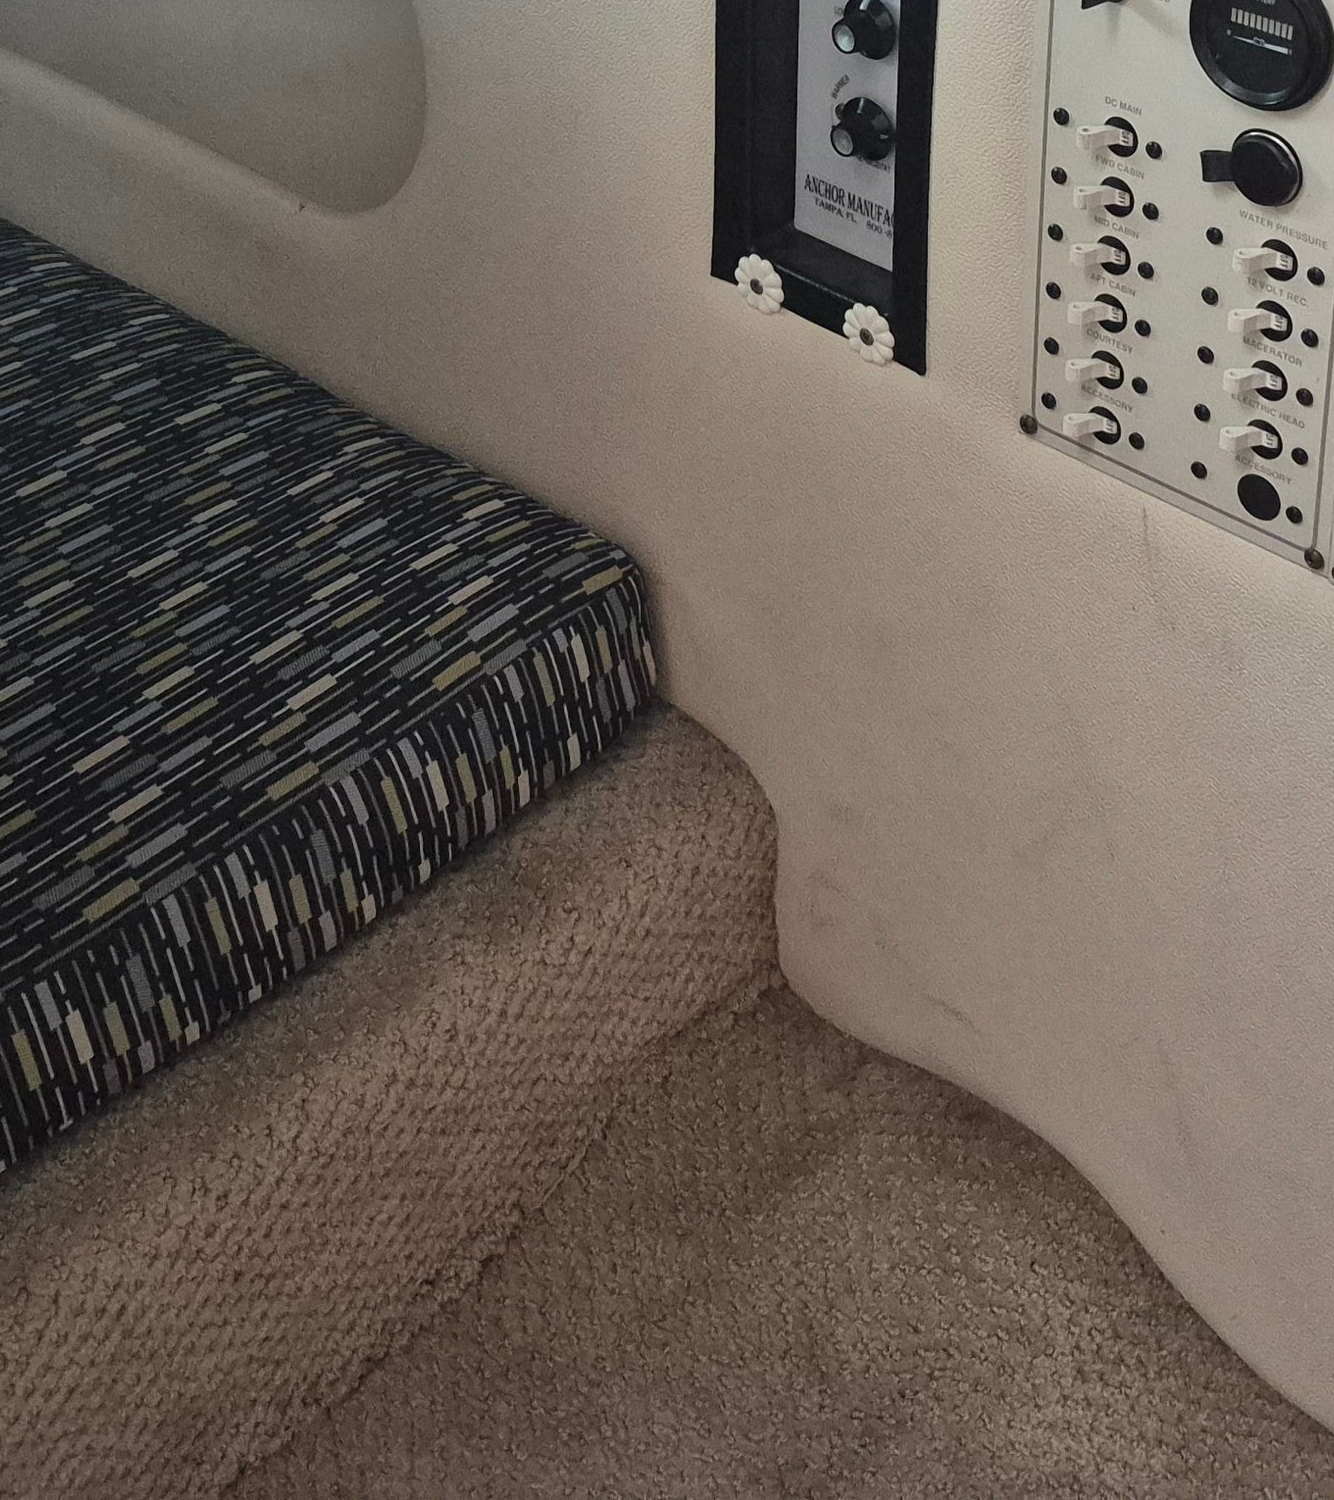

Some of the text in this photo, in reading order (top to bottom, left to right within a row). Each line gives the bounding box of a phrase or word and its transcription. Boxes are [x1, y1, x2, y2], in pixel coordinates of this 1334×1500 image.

[1104, 96, 1142, 116] DC MAIN
[1117, 163, 1145, 179] CABIN
[804, 173, 846, 208] ANCHOR
[1112, 222, 1140, 239] CABIN
[1239, 210, 1329, 249] WATER PRESSURE
[1090, 273, 1136, 297] AFT CABIN
[1259, 282, 1284, 296] VOLT
[1087, 328, 1133, 354] COURTESY
[1243, 336, 1303, 367] MACERATOR
[1081, 383, 1134, 413] ACCESSORY
[1231, 393, 1305, 429] ELECTRIC HEAD
[1235, 454, 1292, 485] ACCESSORY
